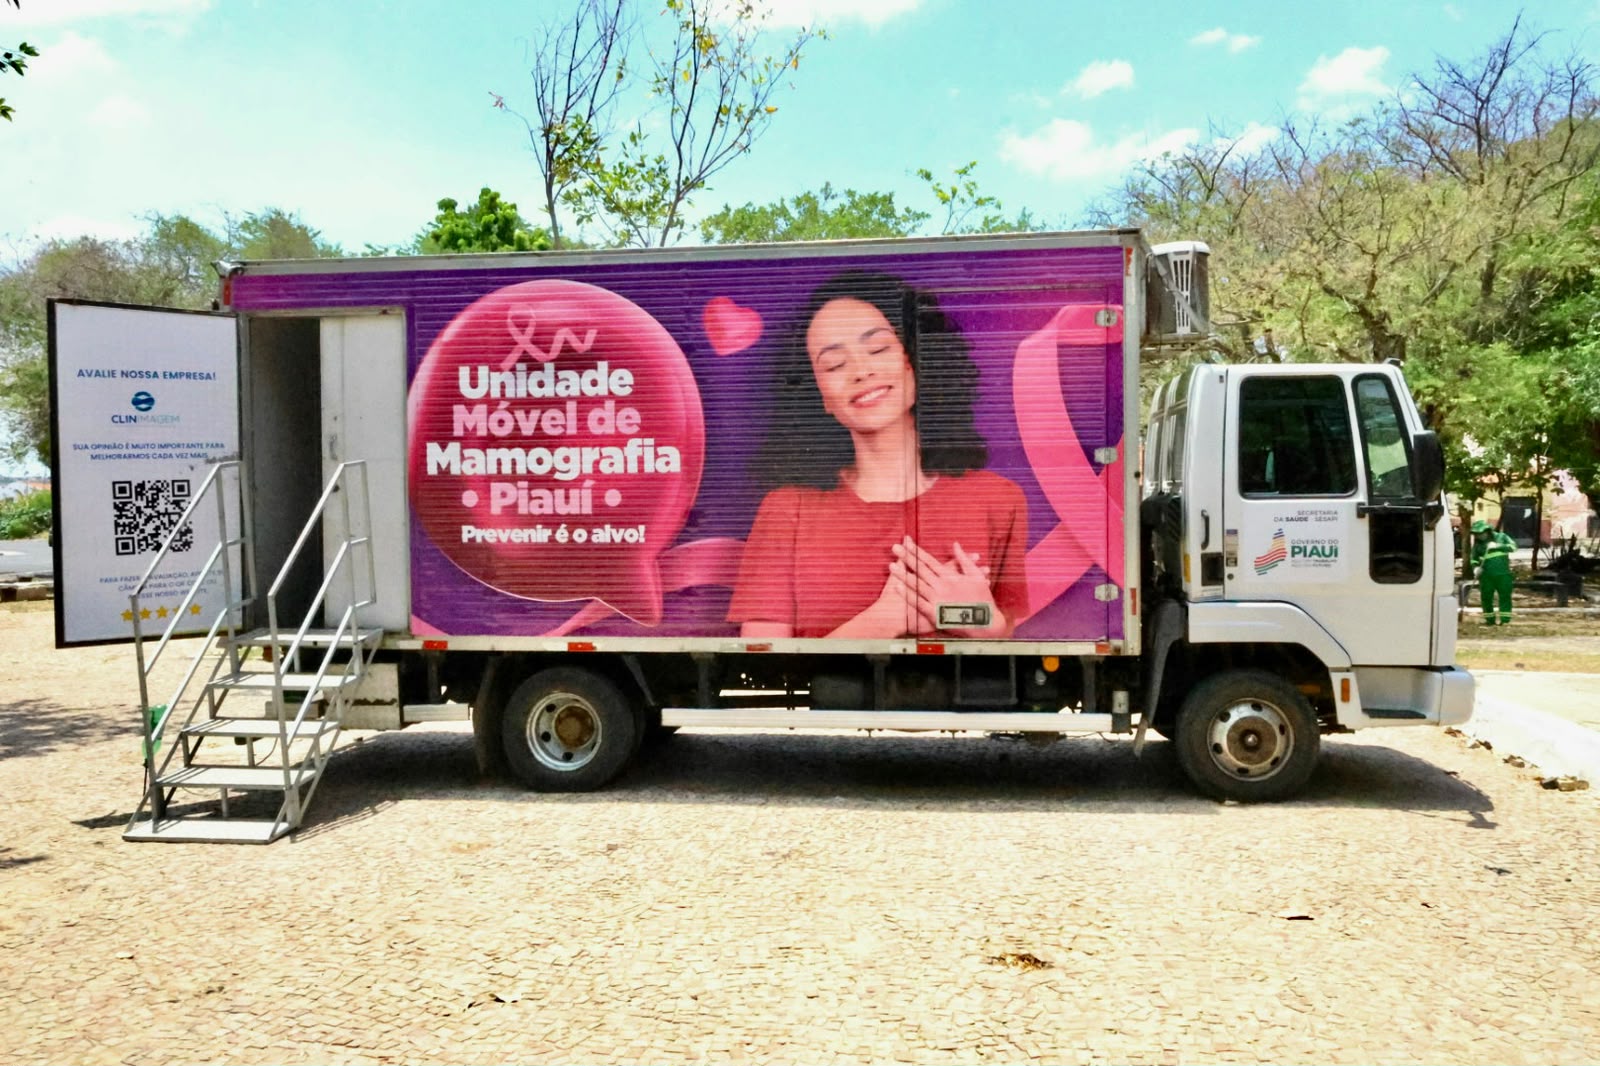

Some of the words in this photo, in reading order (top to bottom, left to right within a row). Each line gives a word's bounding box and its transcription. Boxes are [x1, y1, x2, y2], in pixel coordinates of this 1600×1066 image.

[77, 369, 117, 379] AVALIE
[120, 370, 159, 380] NOSSA
[162, 371, 216, 381] EMPRESA!
[458, 361, 634, 399] Unidade
[452, 401, 577, 437] Móvel
[587, 402, 642, 435] de
[426, 438, 681, 481] Mamografia
[490, 480, 595, 515] Piauí
[461, 524, 552, 544] Prevenir
[555, 524, 569, 543] é
[573, 530, 588, 543] o
[591, 524, 645, 543] alvo!
